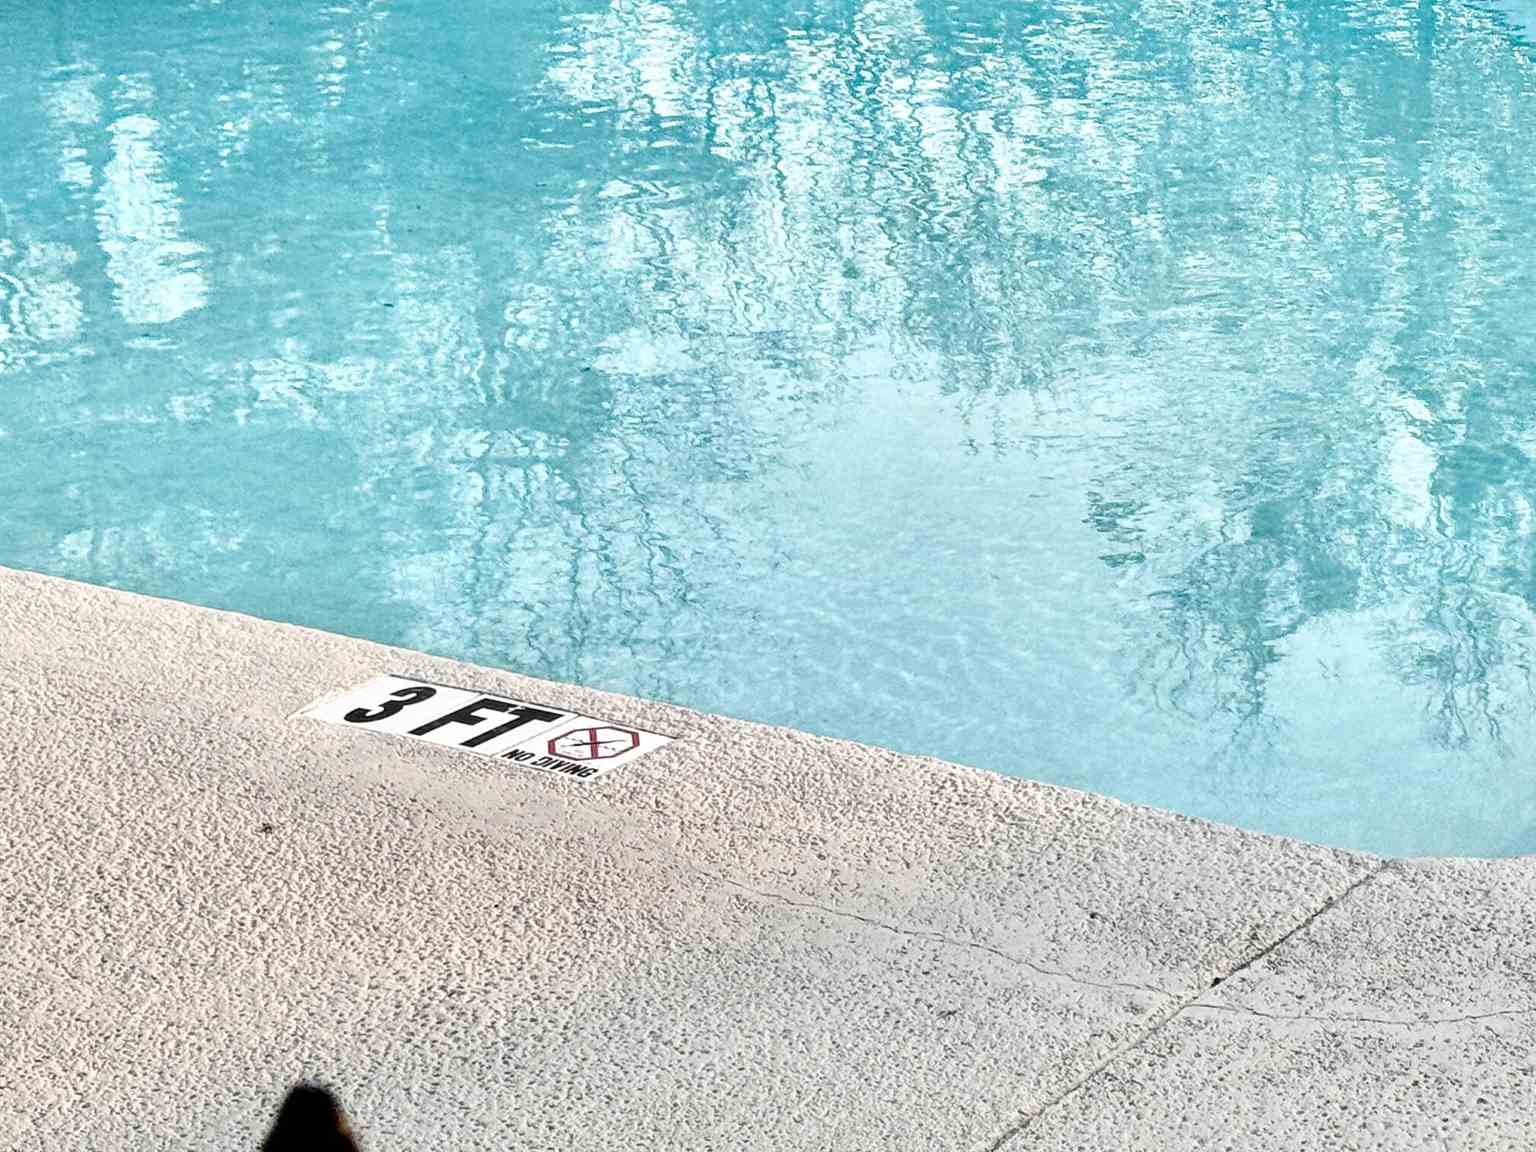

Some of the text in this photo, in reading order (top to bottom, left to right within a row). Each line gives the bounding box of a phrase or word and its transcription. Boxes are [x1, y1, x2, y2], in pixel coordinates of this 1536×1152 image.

[343, 686, 566, 748] 3 FT
[501, 749, 599, 778] NO DIVING
